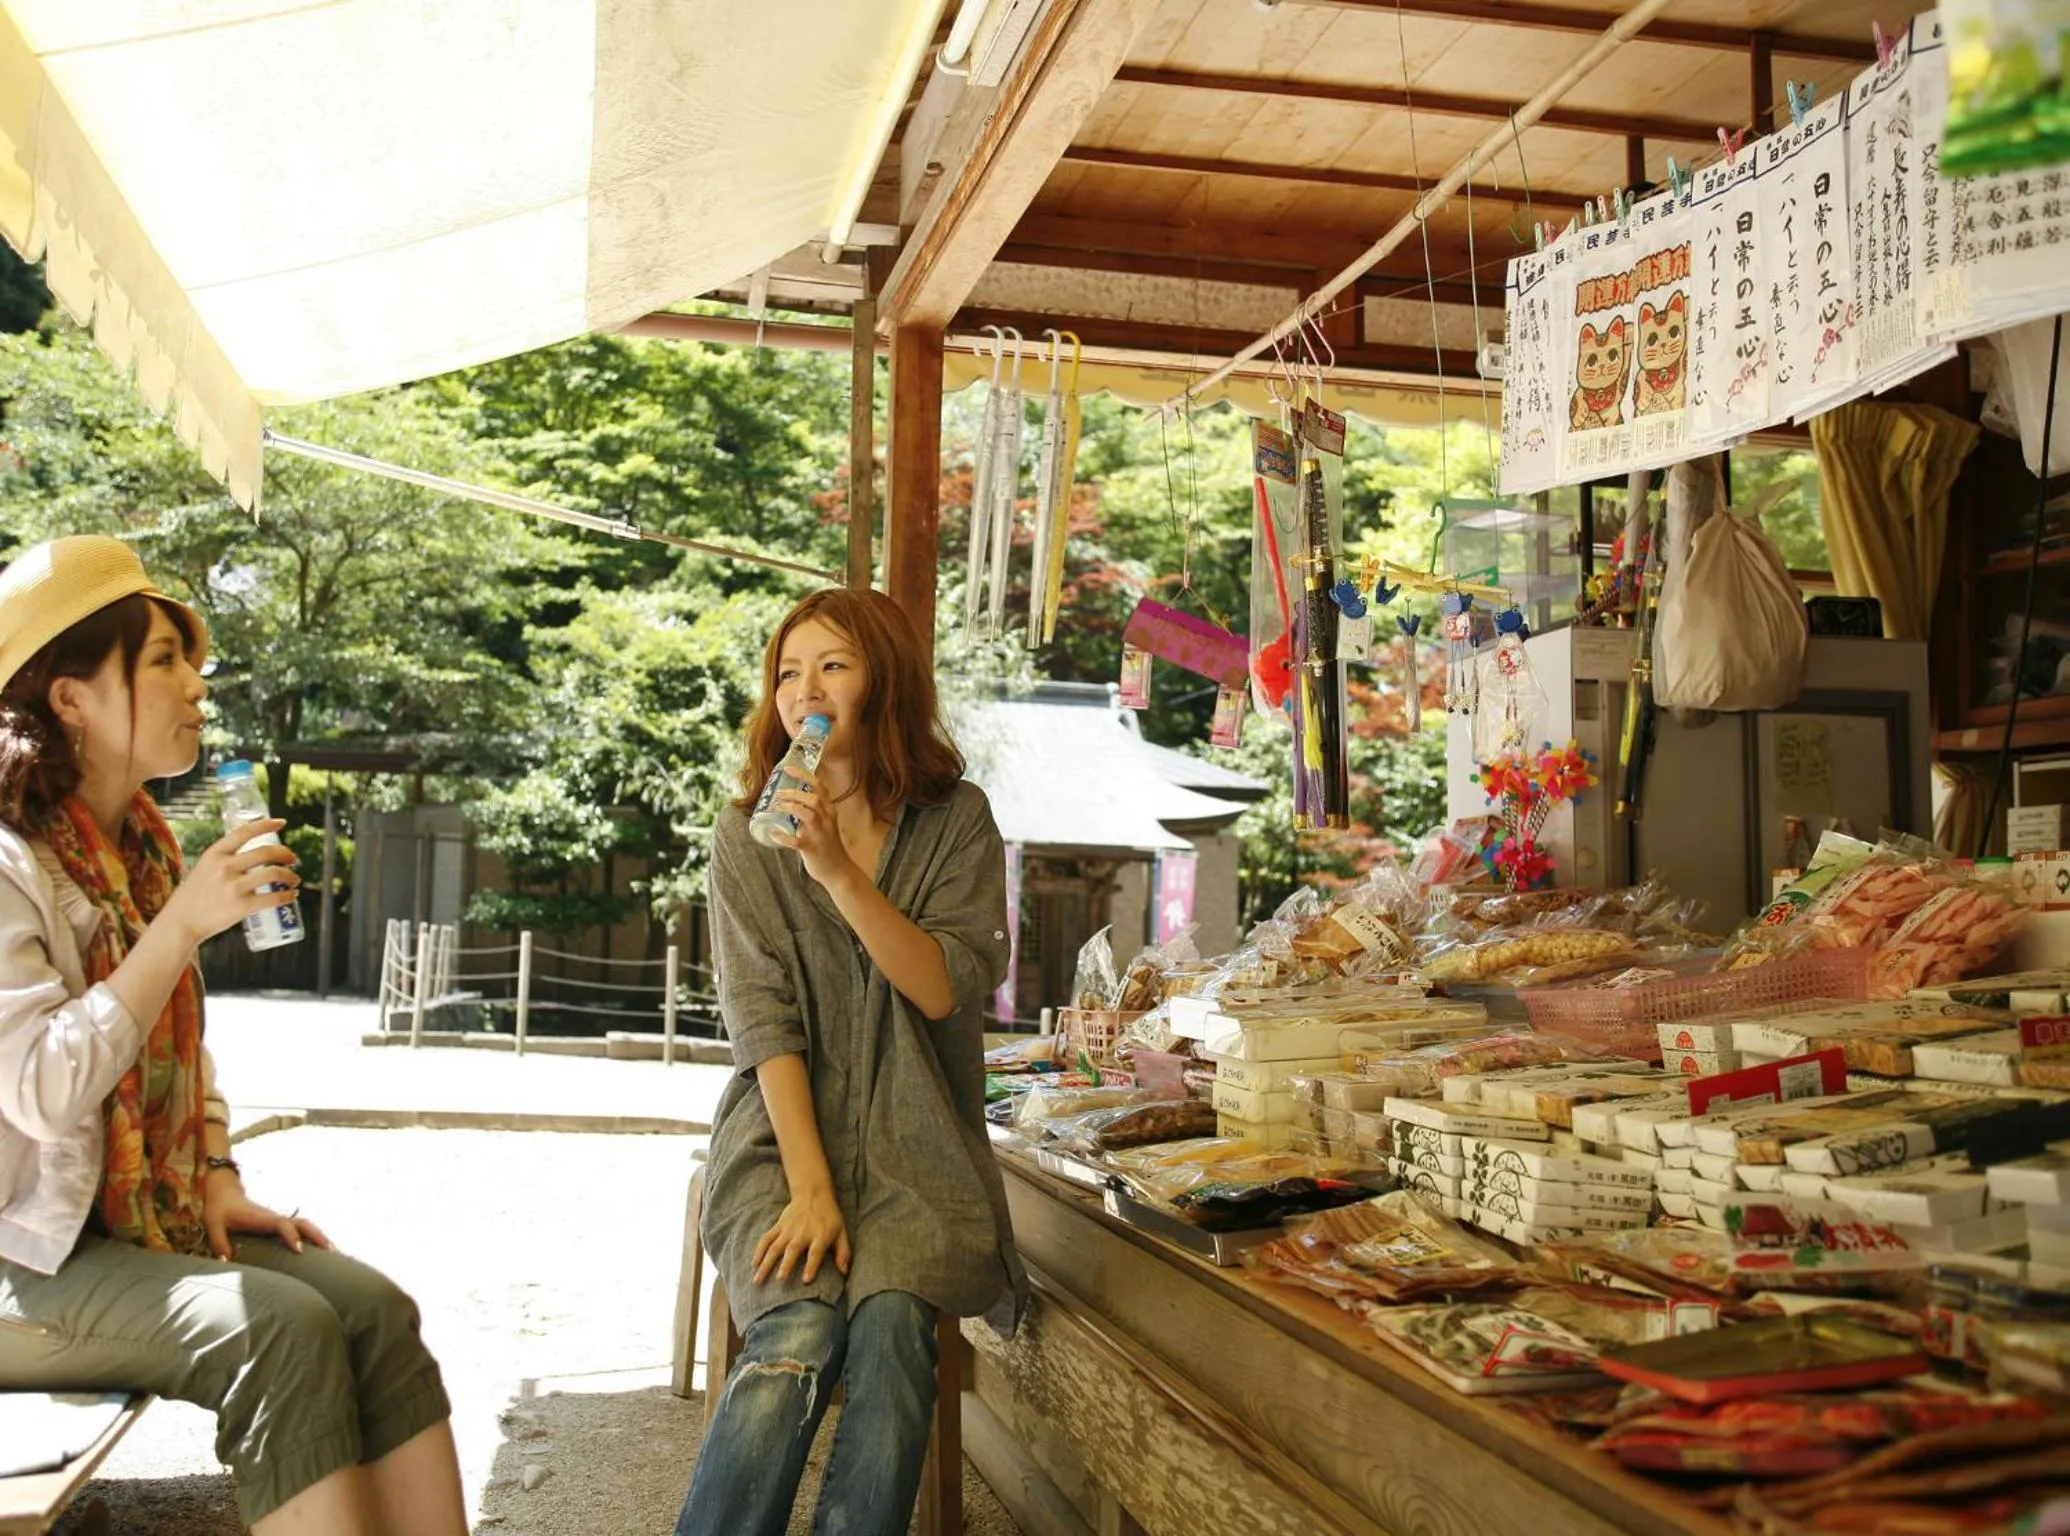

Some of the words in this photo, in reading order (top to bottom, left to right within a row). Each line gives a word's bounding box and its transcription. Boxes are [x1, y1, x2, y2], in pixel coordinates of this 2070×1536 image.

[1733, 210, 1761, 359] 日常の五心
[1813, 171, 1844, 324] 日常の五心
[1769, 281, 1794, 385] 素直な心
